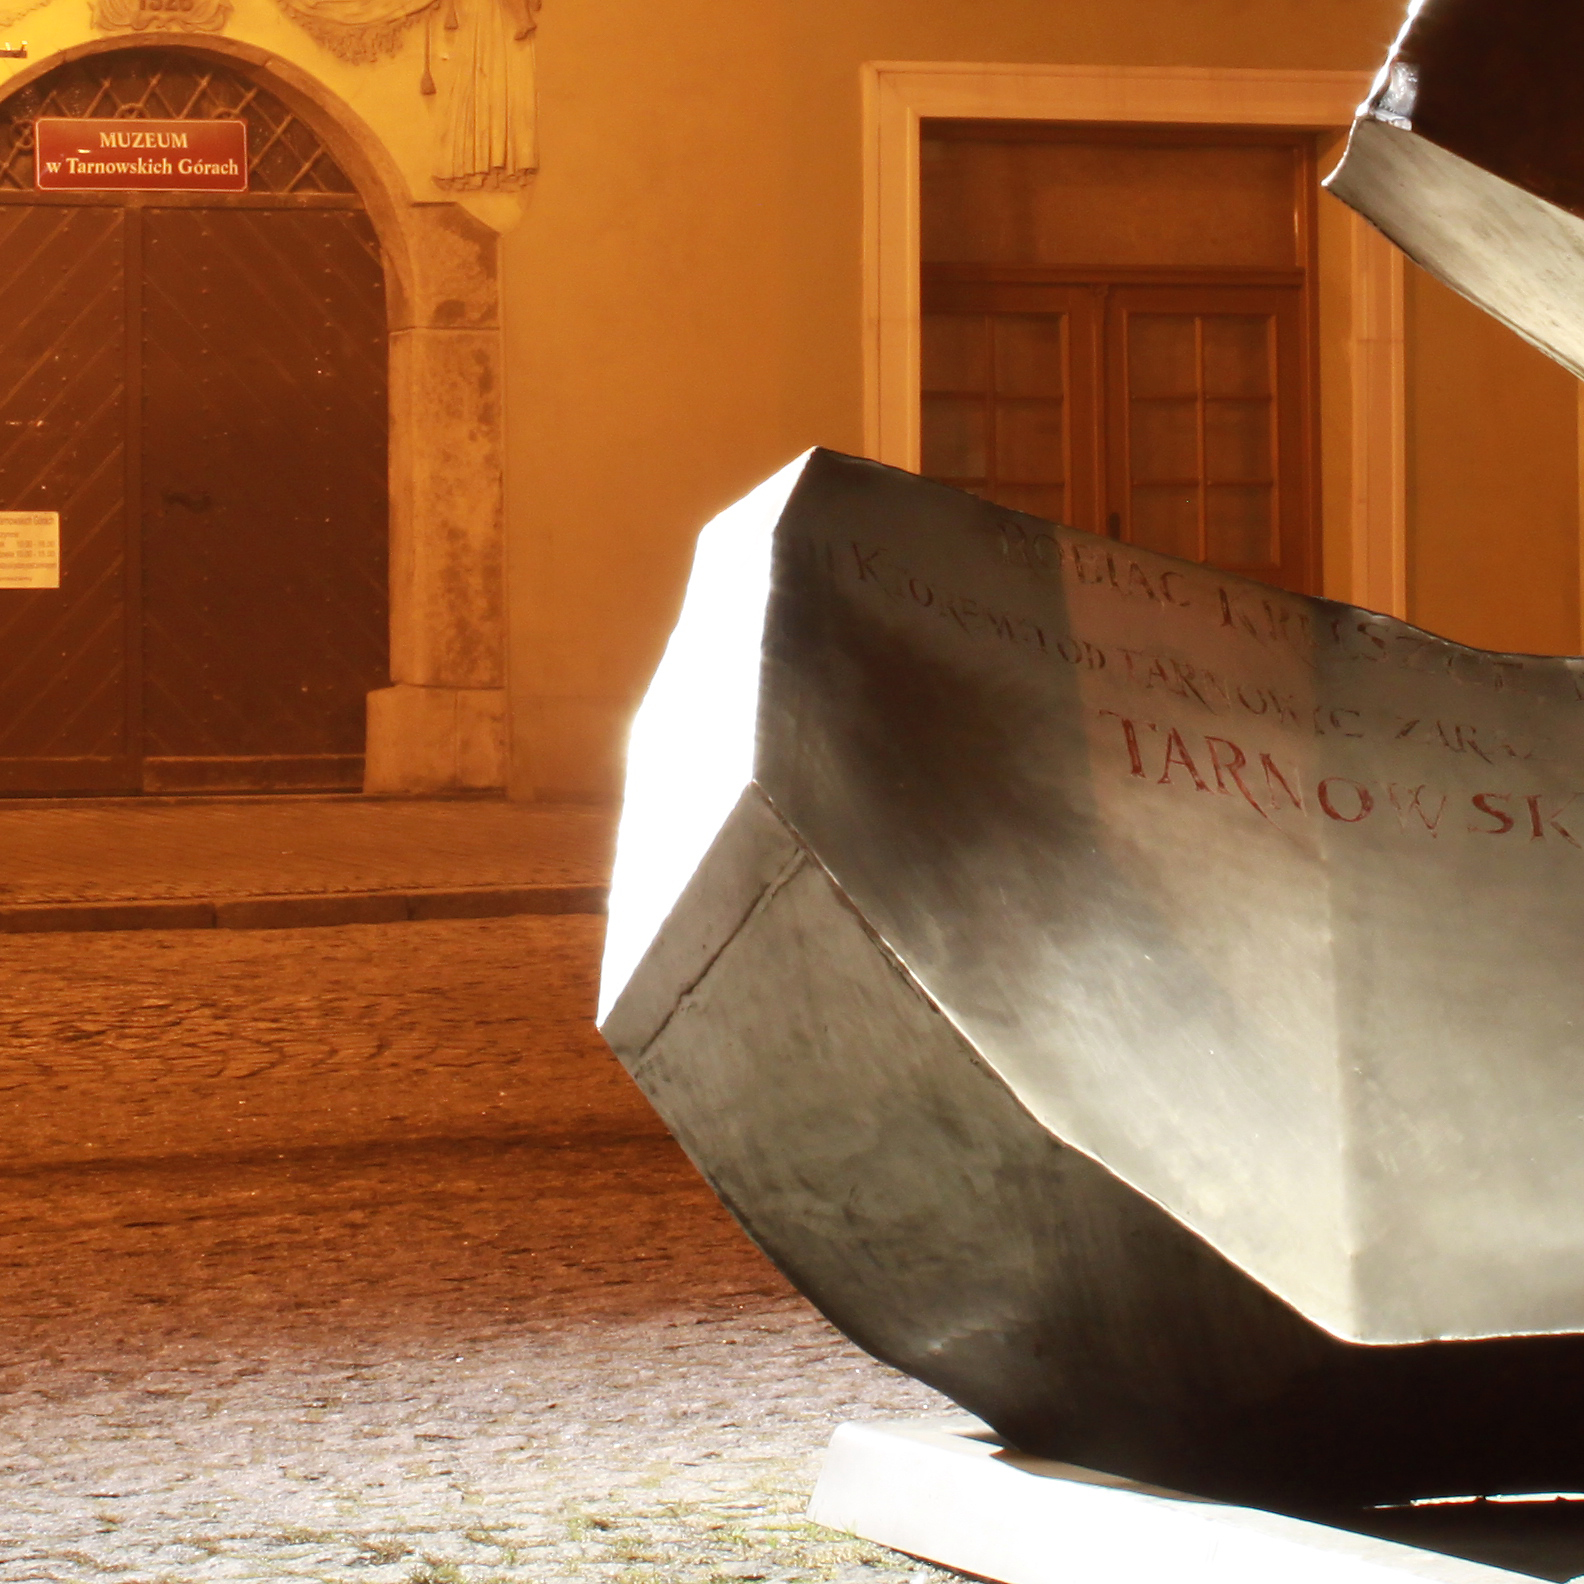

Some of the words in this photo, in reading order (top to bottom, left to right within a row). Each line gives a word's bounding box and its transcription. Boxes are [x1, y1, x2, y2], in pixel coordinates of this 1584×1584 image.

[99, 132, 188, 149] MUZEUM
[46, 161, 62, 174] w
[66, 157, 172, 175] Tarnowskich
[178, 158, 239, 176] Górach
